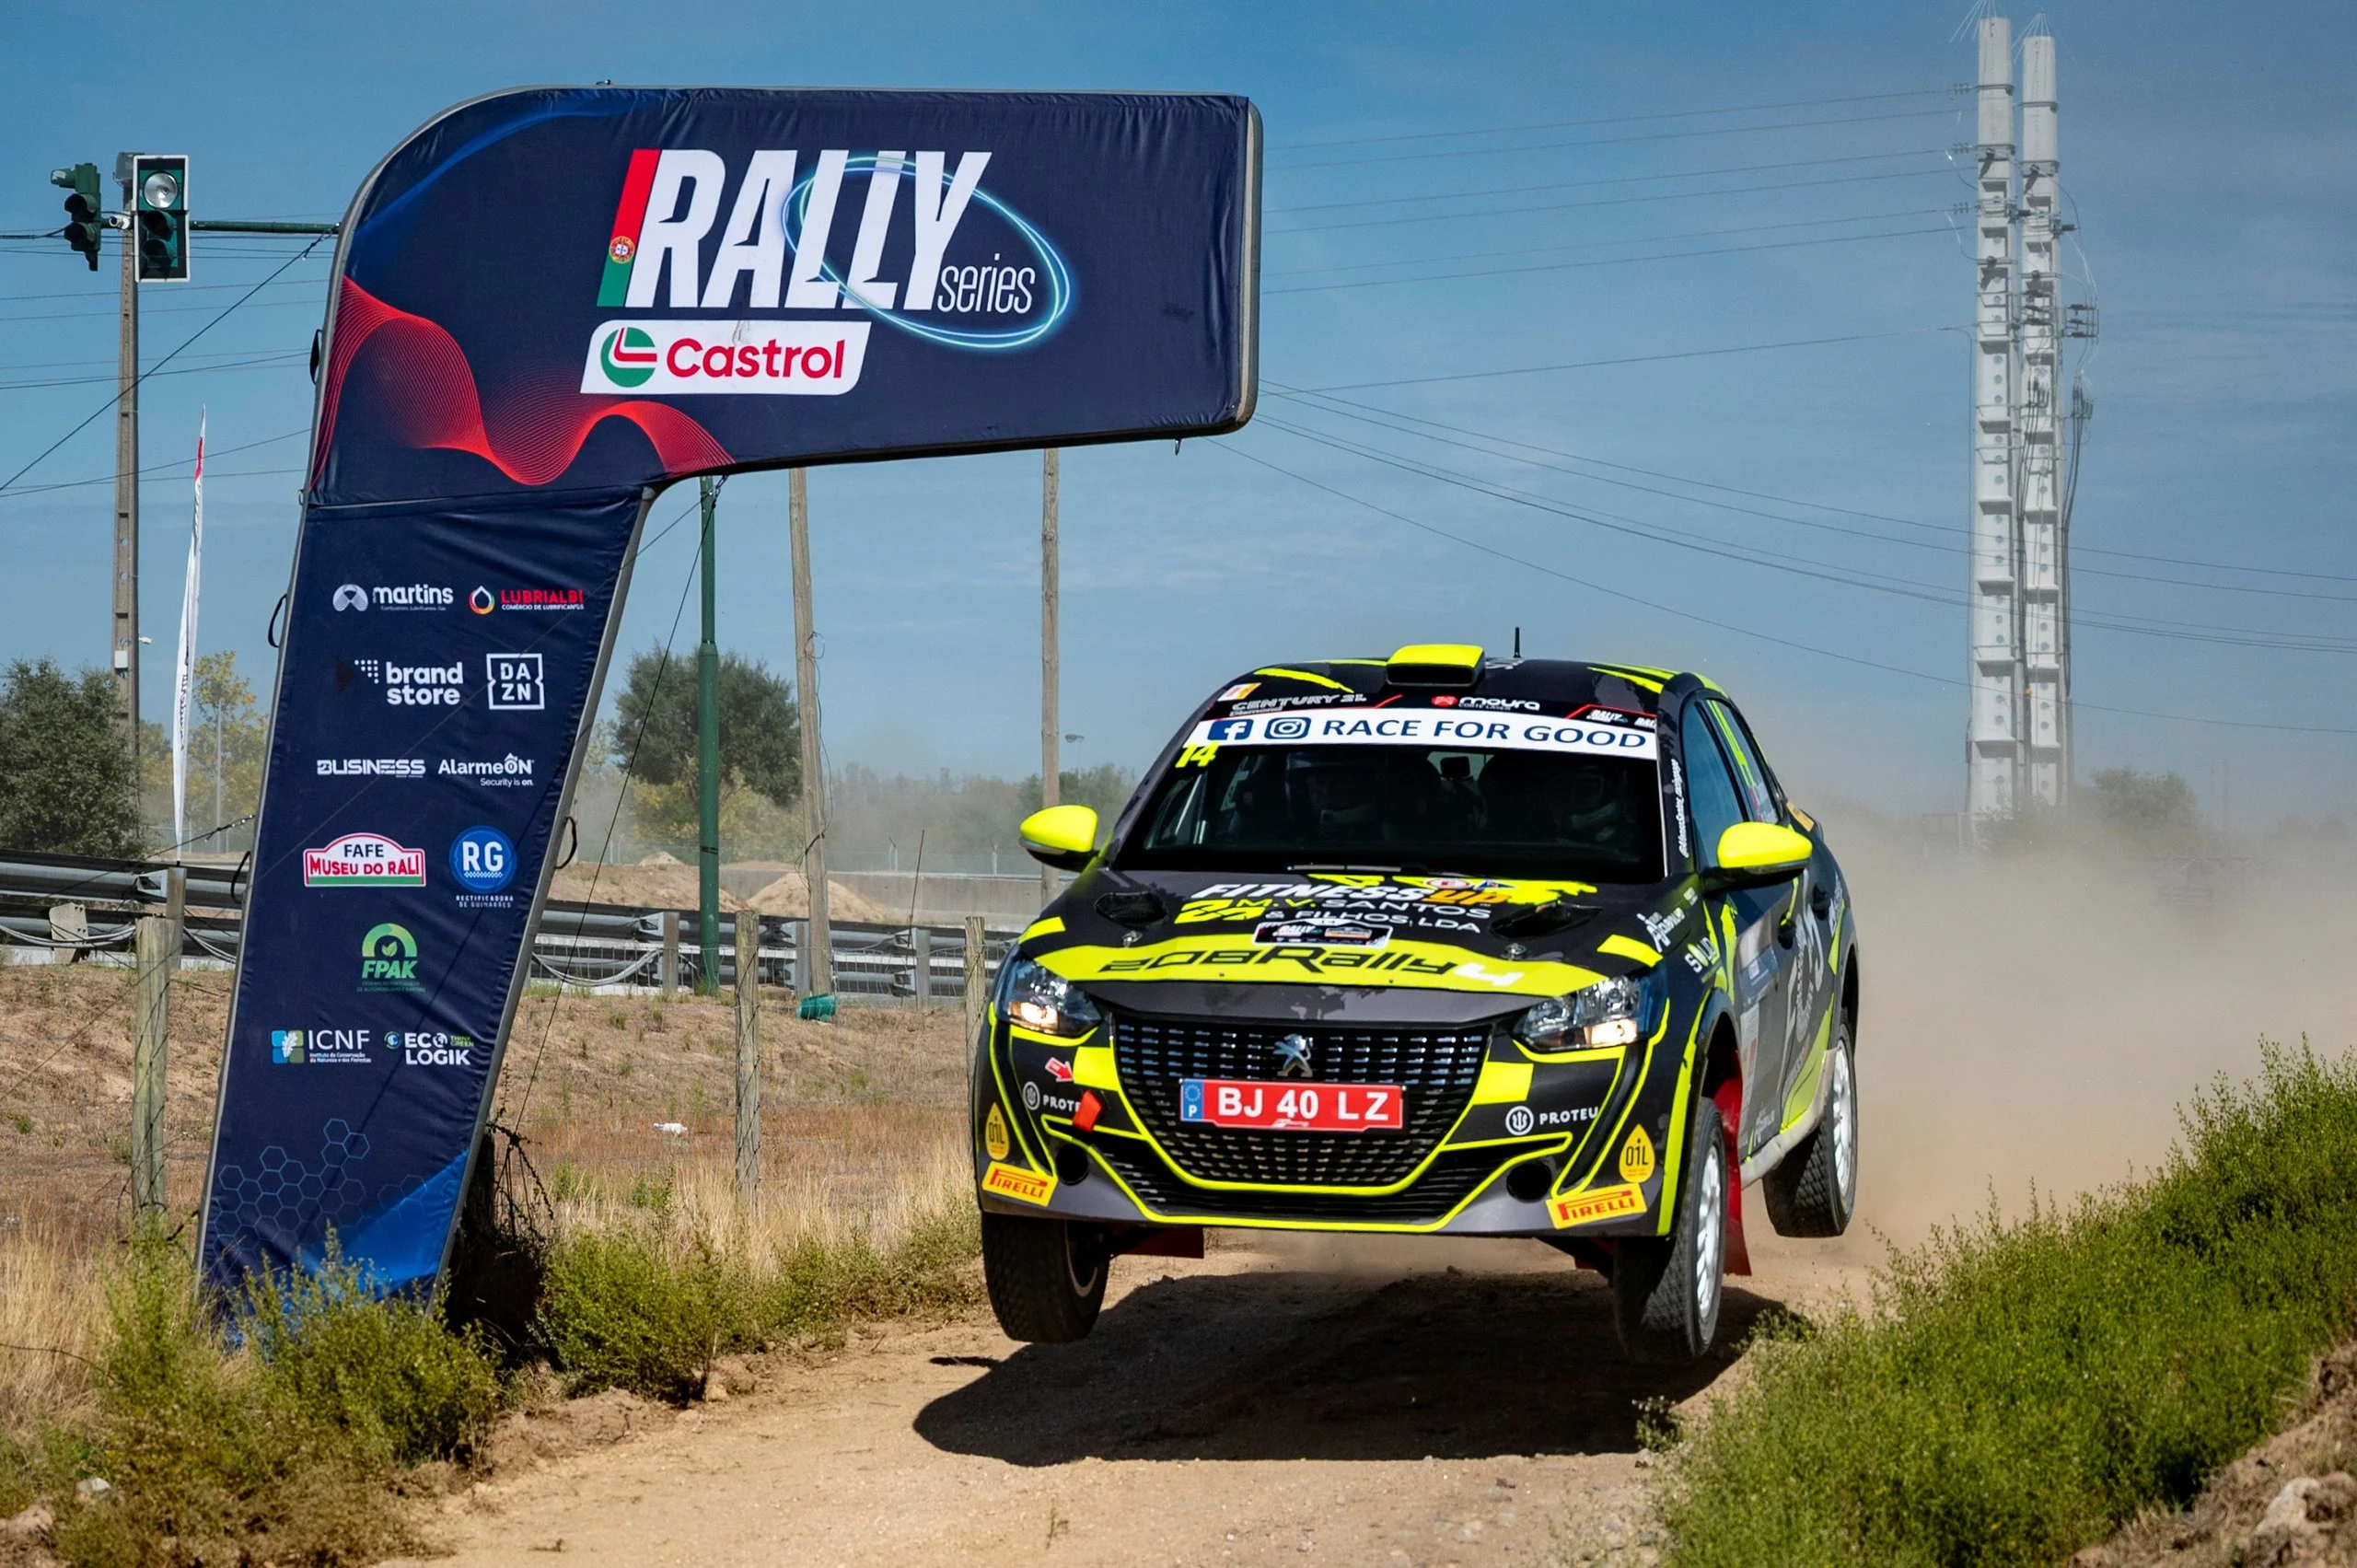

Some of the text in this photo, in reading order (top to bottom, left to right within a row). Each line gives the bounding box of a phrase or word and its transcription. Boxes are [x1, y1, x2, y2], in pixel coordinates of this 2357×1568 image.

[625, 149, 992, 310] RALLY
[937, 253, 1036, 313] series
[666, 339, 845, 378] Castrol
[372, 584, 454, 604] martins
[500, 589, 585, 604] LUBRIALBI
[386, 662, 463, 684] brand
[387, 684, 460, 705] store
[1232, 694, 1341, 711] CENTURY
[1459, 696, 1540, 711] moura
[1322, 719, 1646, 748] RACE FOR GOOD
[1175, 740, 1220, 768] 14
[317, 759, 426, 775] BUSINESS
[480, 777, 513, 787] Security
[514, 777, 520, 785] is
[343, 844, 384, 857] FAFE
[462, 841, 504, 872] RG
[309, 854, 420, 875] MUSEU DO RALI
[1190, 884, 1435, 900] FITNESS
[1321, 900, 1492, 919] SANTOS
[1265, 911, 1285, 919] &
[1418, 917, 1480, 933] LDA
[362, 960, 418, 979] FPAK
[308, 1029, 370, 1050] ICNF
[406, 1050, 470, 1065] LOGIK
[1188, 1086, 1388, 1121] P BJ 40 LZ
[1539, 1107, 1598, 1125] PROTEU
[990, 1168, 1049, 1198] PIRELLI
[1557, 1191, 1635, 1221] PIRELLI
